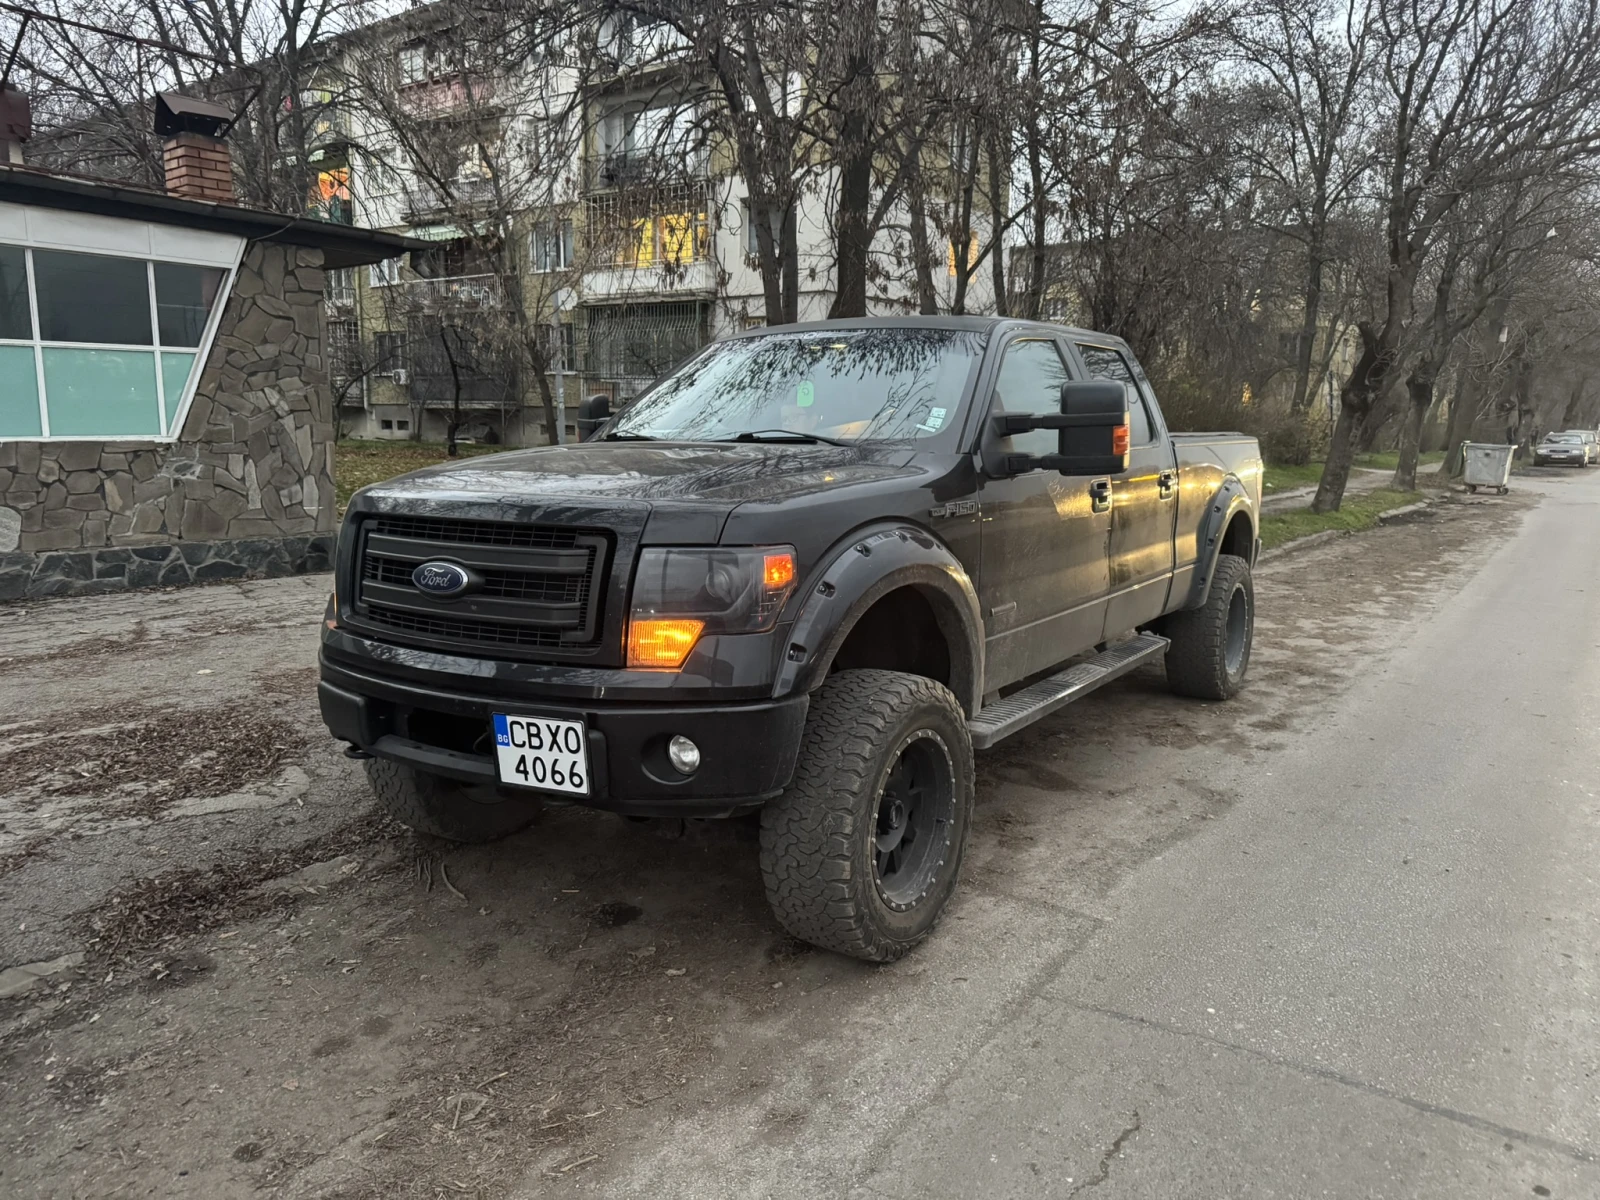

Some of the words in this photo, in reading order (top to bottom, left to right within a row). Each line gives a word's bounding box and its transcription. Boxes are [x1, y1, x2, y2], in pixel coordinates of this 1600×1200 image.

[420, 567, 452, 587] Ford
[498, 734, 508, 743] BG
[515, 754, 584, 788] 4066
